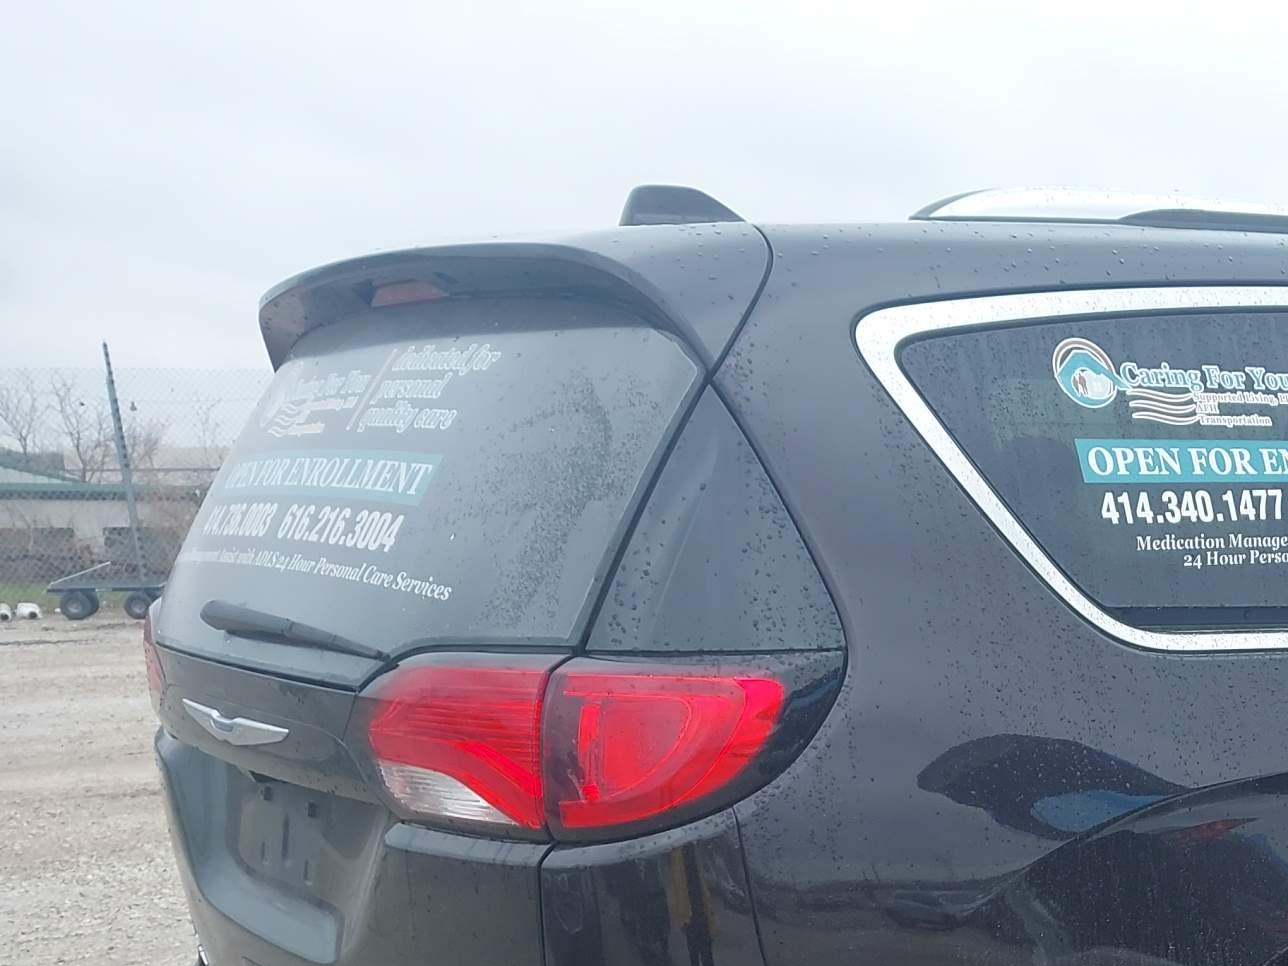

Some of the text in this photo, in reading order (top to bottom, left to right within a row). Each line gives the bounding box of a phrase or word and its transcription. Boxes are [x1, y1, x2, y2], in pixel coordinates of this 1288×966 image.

[1120, 362, 1204, 392] Caring
[1202, 365, 1245, 389] For
[1199, 413, 1273, 428] Transportation
[287, 457, 433, 495] ENROLLMENT
[1087, 447, 1182, 476] OPEN
[1187, 448, 1258, 476] FOR
[1101, 489, 1283, 524] 414.340.1477
[277, 503, 404, 552] 616.216.3004
[1136, 534, 1225, 551] Medication
[1183, 555, 1202, 569] 24
[1207, 551, 1246, 566] Hour
[287, 553, 317, 573] Hour
[313, 557, 366, 582] Personal
[362, 564, 394, 588] Care
[391, 571, 452, 600] Services
